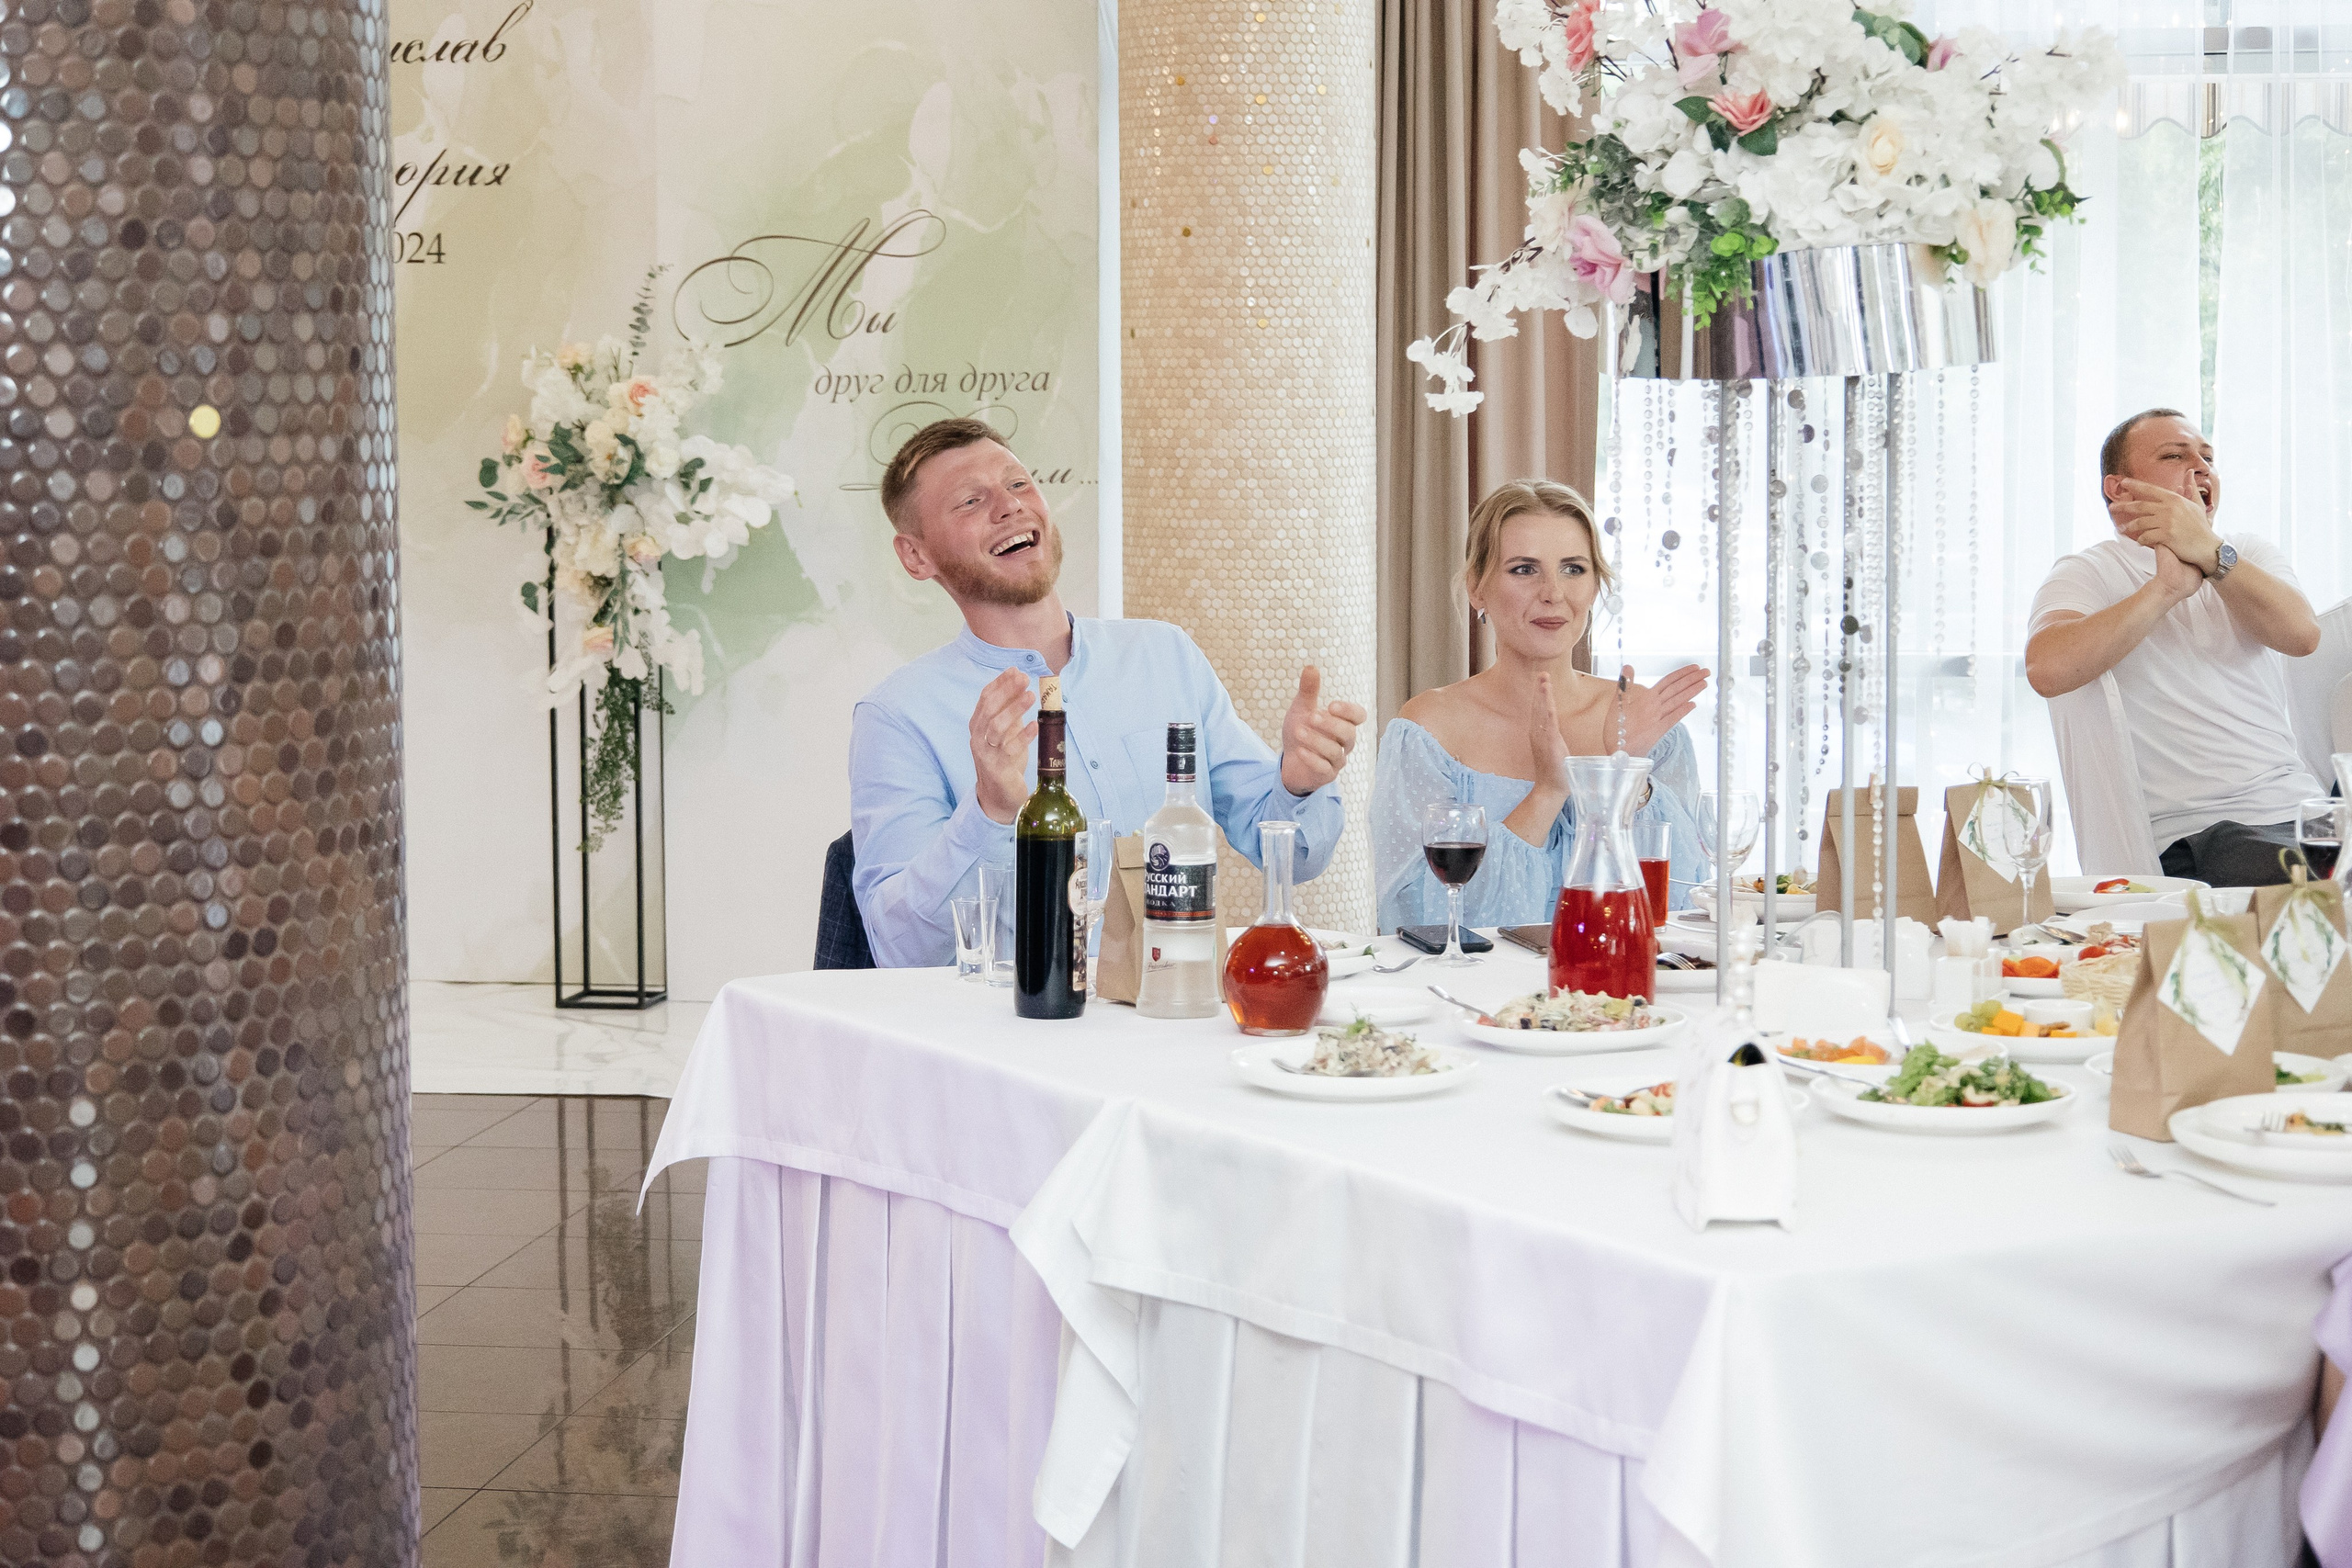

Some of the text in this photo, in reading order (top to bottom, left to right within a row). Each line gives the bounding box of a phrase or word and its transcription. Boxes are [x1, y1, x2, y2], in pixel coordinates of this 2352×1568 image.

[673, 209, 946, 347] Мы
[815, 362, 1050, 403] друг для друга
